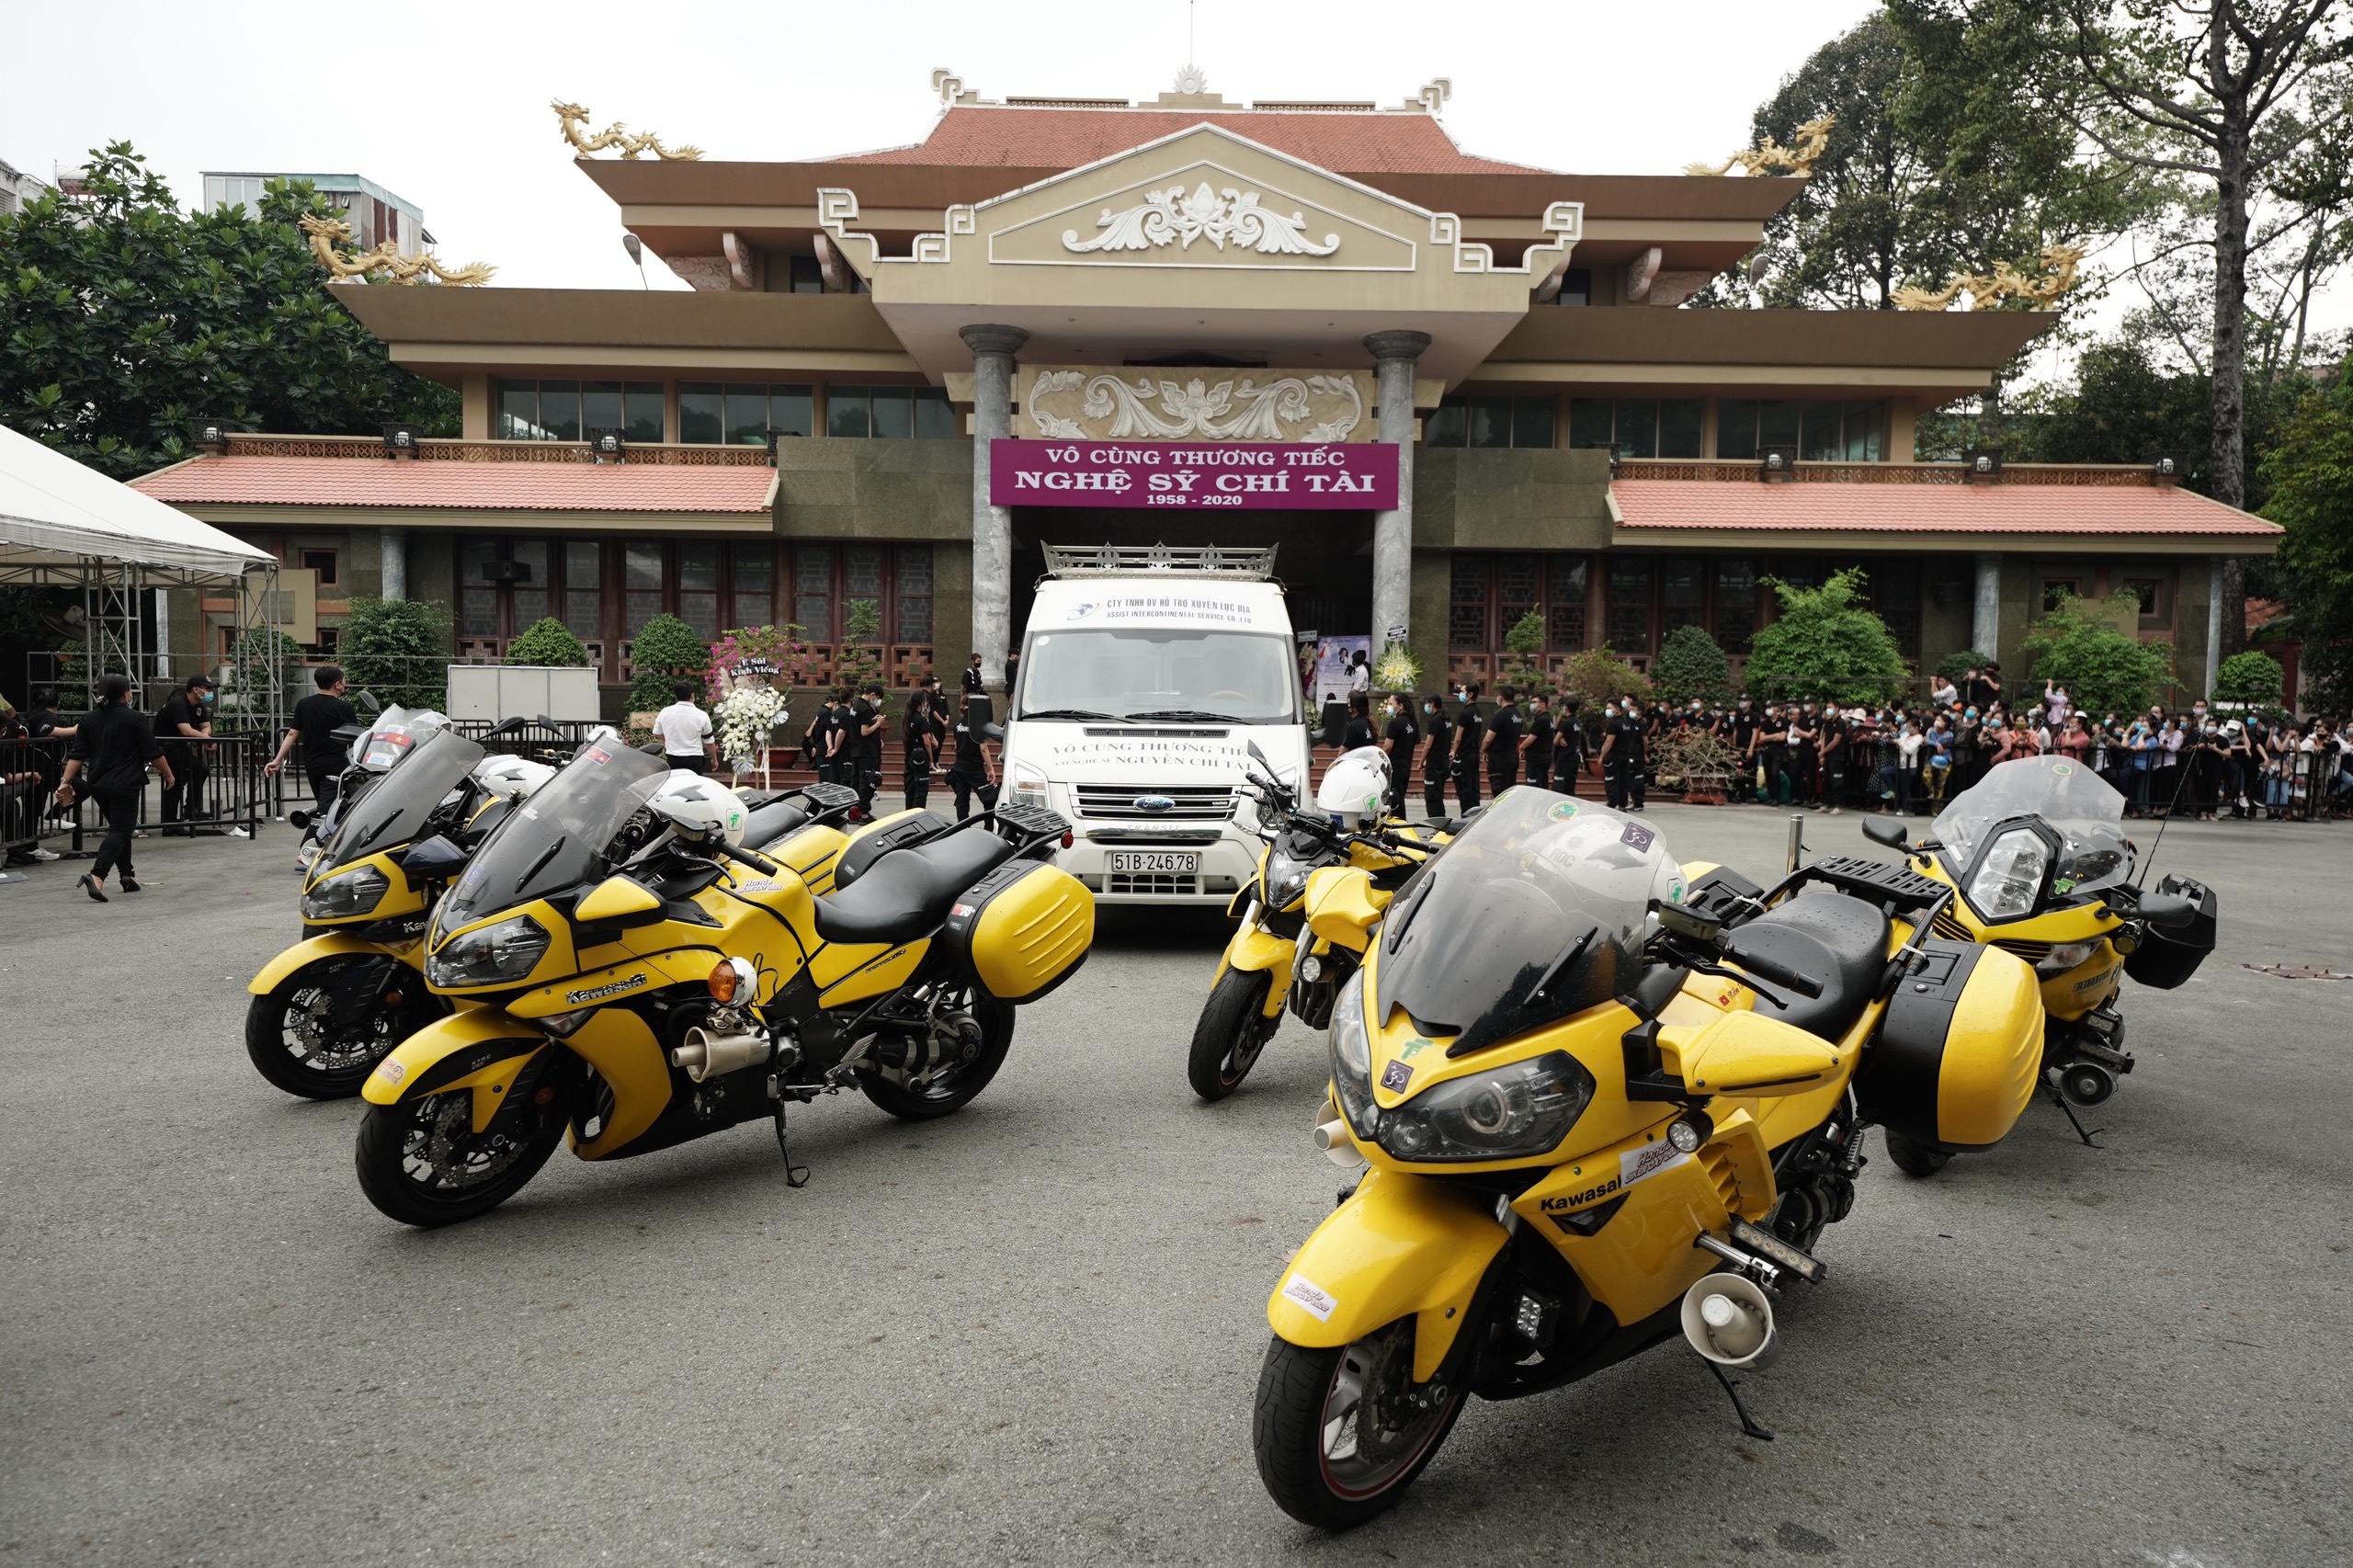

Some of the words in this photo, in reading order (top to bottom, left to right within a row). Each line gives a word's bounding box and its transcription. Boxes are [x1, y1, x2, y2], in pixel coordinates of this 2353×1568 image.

[1045, 446, 1080, 463] VÔ
[1089, 447, 1162, 464] CÙNG
[1169, 449, 1276, 466] THƯƠNG
[1283, 446, 1346, 466] TIẾC
[1014, 469, 1133, 494] NGHỆ
[1148, 470, 1201, 492] SỸ
[1215, 470, 1290, 492] CHÍ
[1303, 470, 1375, 493] TÀI
[1146, 494, 1187, 505] 1958
[1201, 494, 1243, 506] 2020
[1107, 598, 1121, 608] CTY
[1125, 598, 1144, 607] TNHH
[1131, 610, 1195, 619] INTERCONTINENTAL
[1197, 612, 1224, 620] SERVICE
[1053, 743, 1076, 754] VÔ
[1082, 741, 1131, 752] CÙNG
[1138, 742, 1211, 753] THƯƠNG
[1142, 798, 1165, 808] Ford
[1114, 854, 1195, 870] 51B-246.78
[565, 971, 648, 1005] Kawasaki
